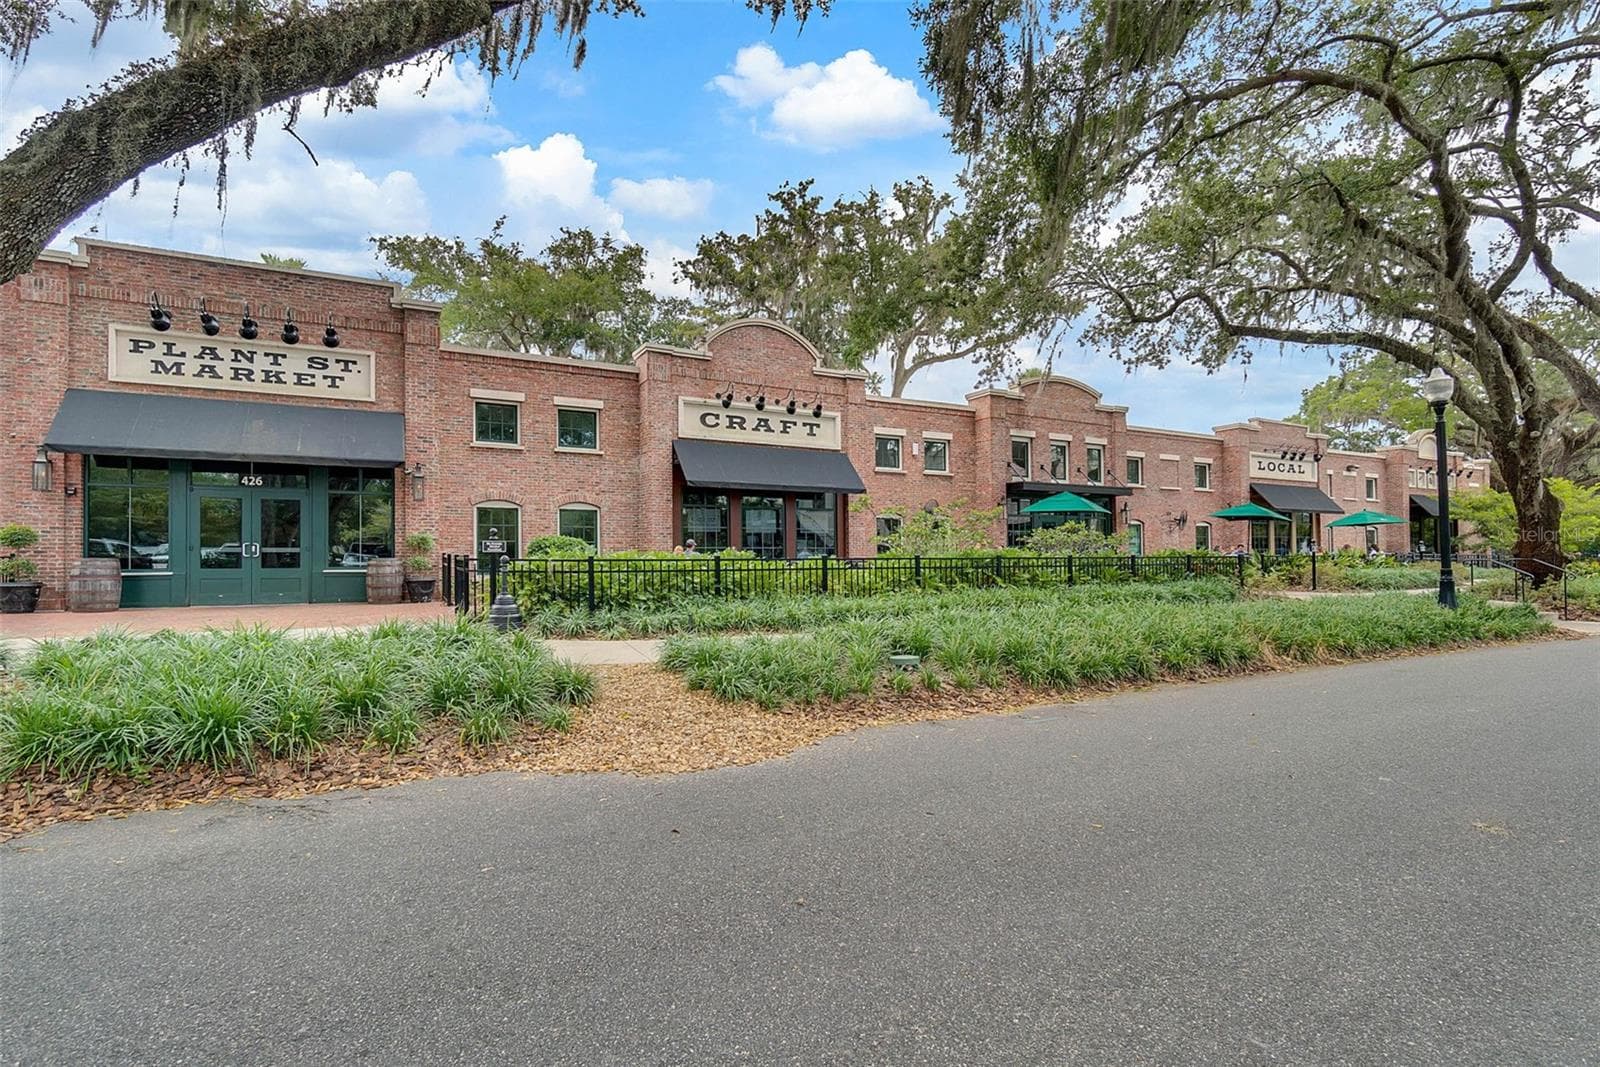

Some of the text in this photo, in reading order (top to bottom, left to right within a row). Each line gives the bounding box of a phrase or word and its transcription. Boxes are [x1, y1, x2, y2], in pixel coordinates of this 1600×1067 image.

[128, 338, 362, 374] PLANT ST.
[149, 359, 345, 388] MARKET
[699, 412, 821, 437] CRAFT
[1257, 460, 1306, 475] LOCAL
[241, 476, 263, 486] 426
